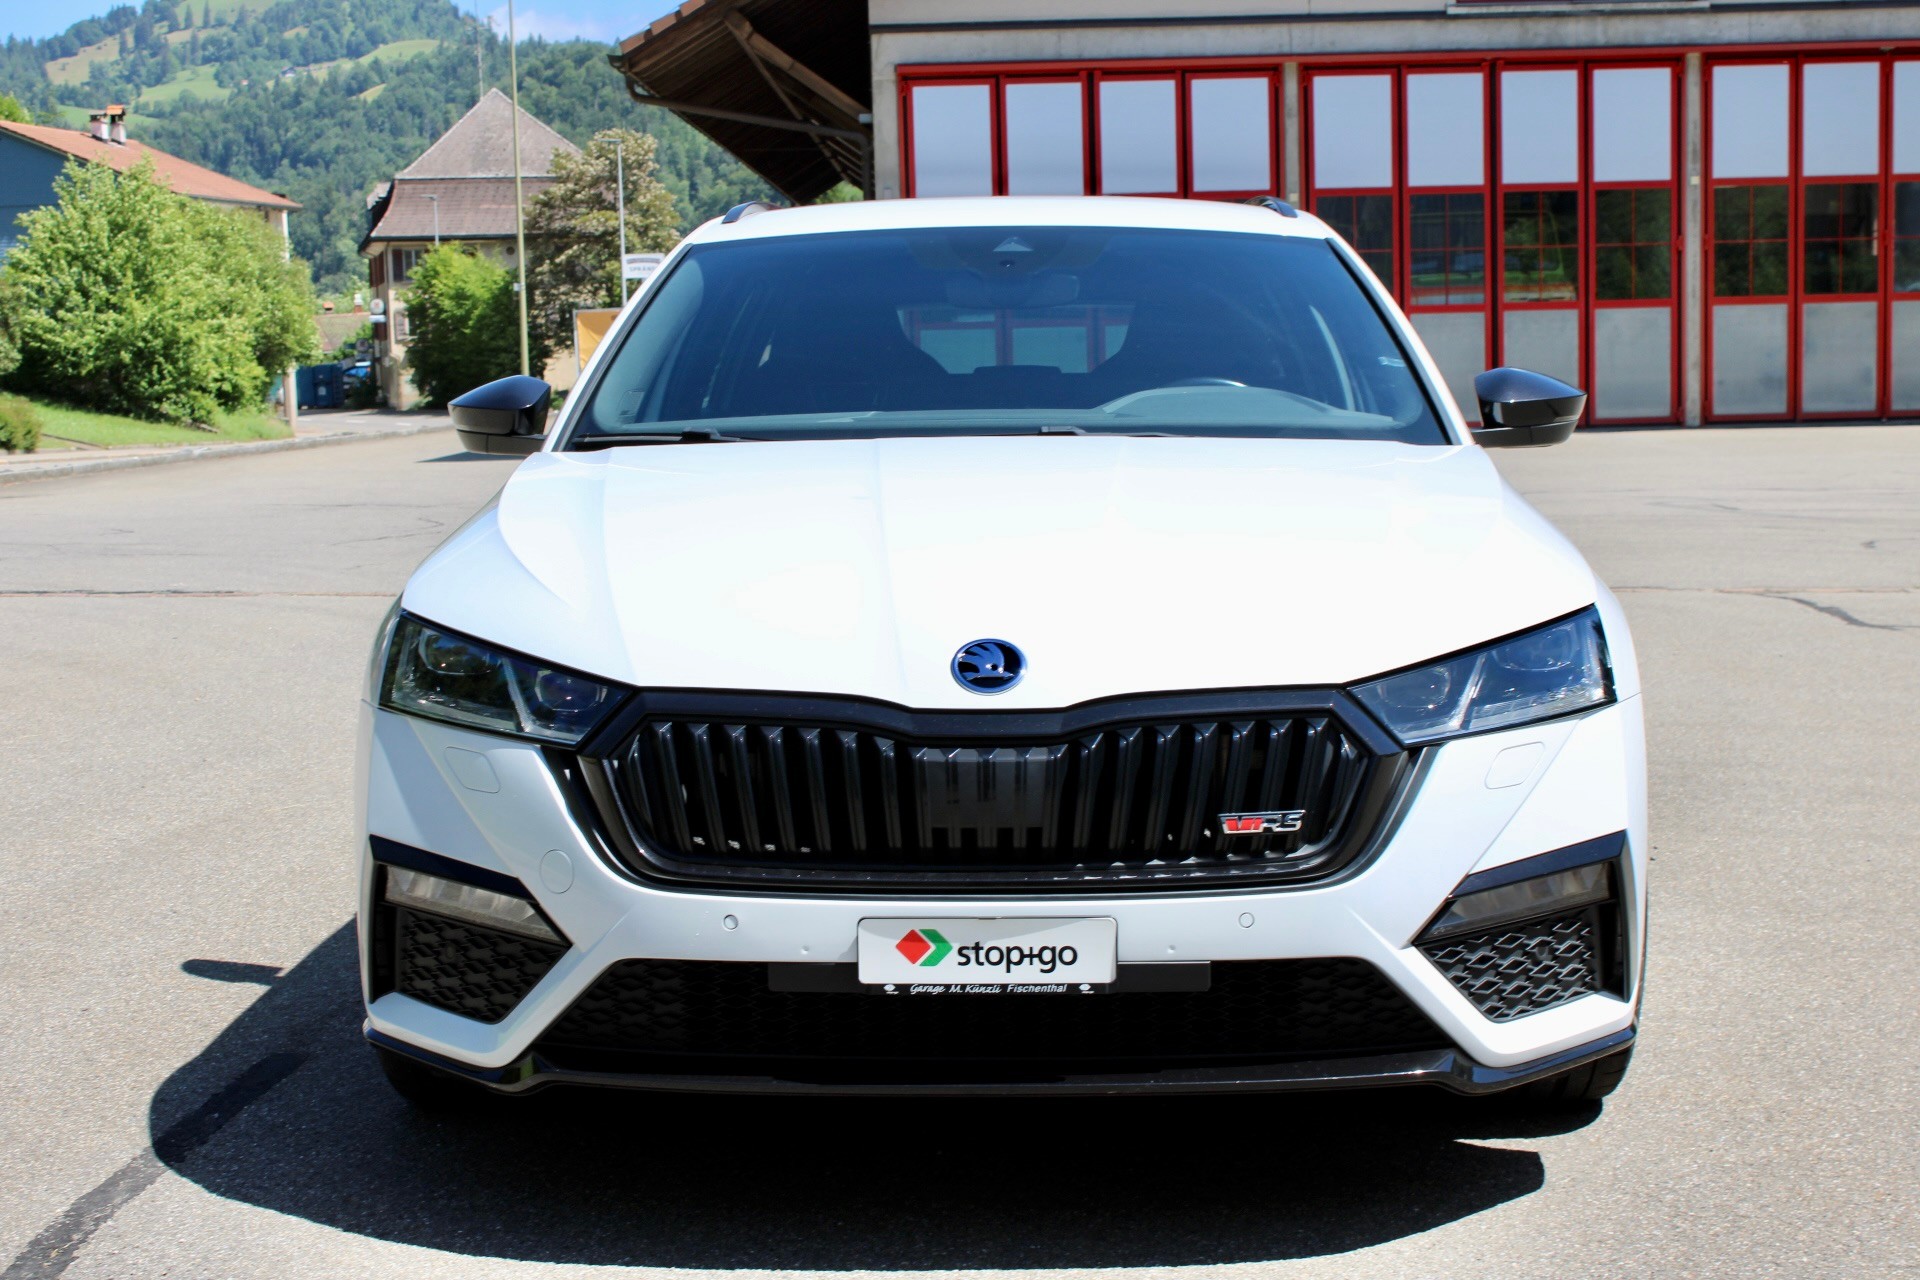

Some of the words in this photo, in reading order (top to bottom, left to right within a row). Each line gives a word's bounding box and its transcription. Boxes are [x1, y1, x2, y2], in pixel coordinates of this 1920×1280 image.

[957, 941, 1078, 974] stop+go
[910, 984, 946, 994] Garage
[949, 984, 963, 993] M.
[965, 984, 1003, 994] Künzli
[1007, 984, 1067, 993] Fischenthal
